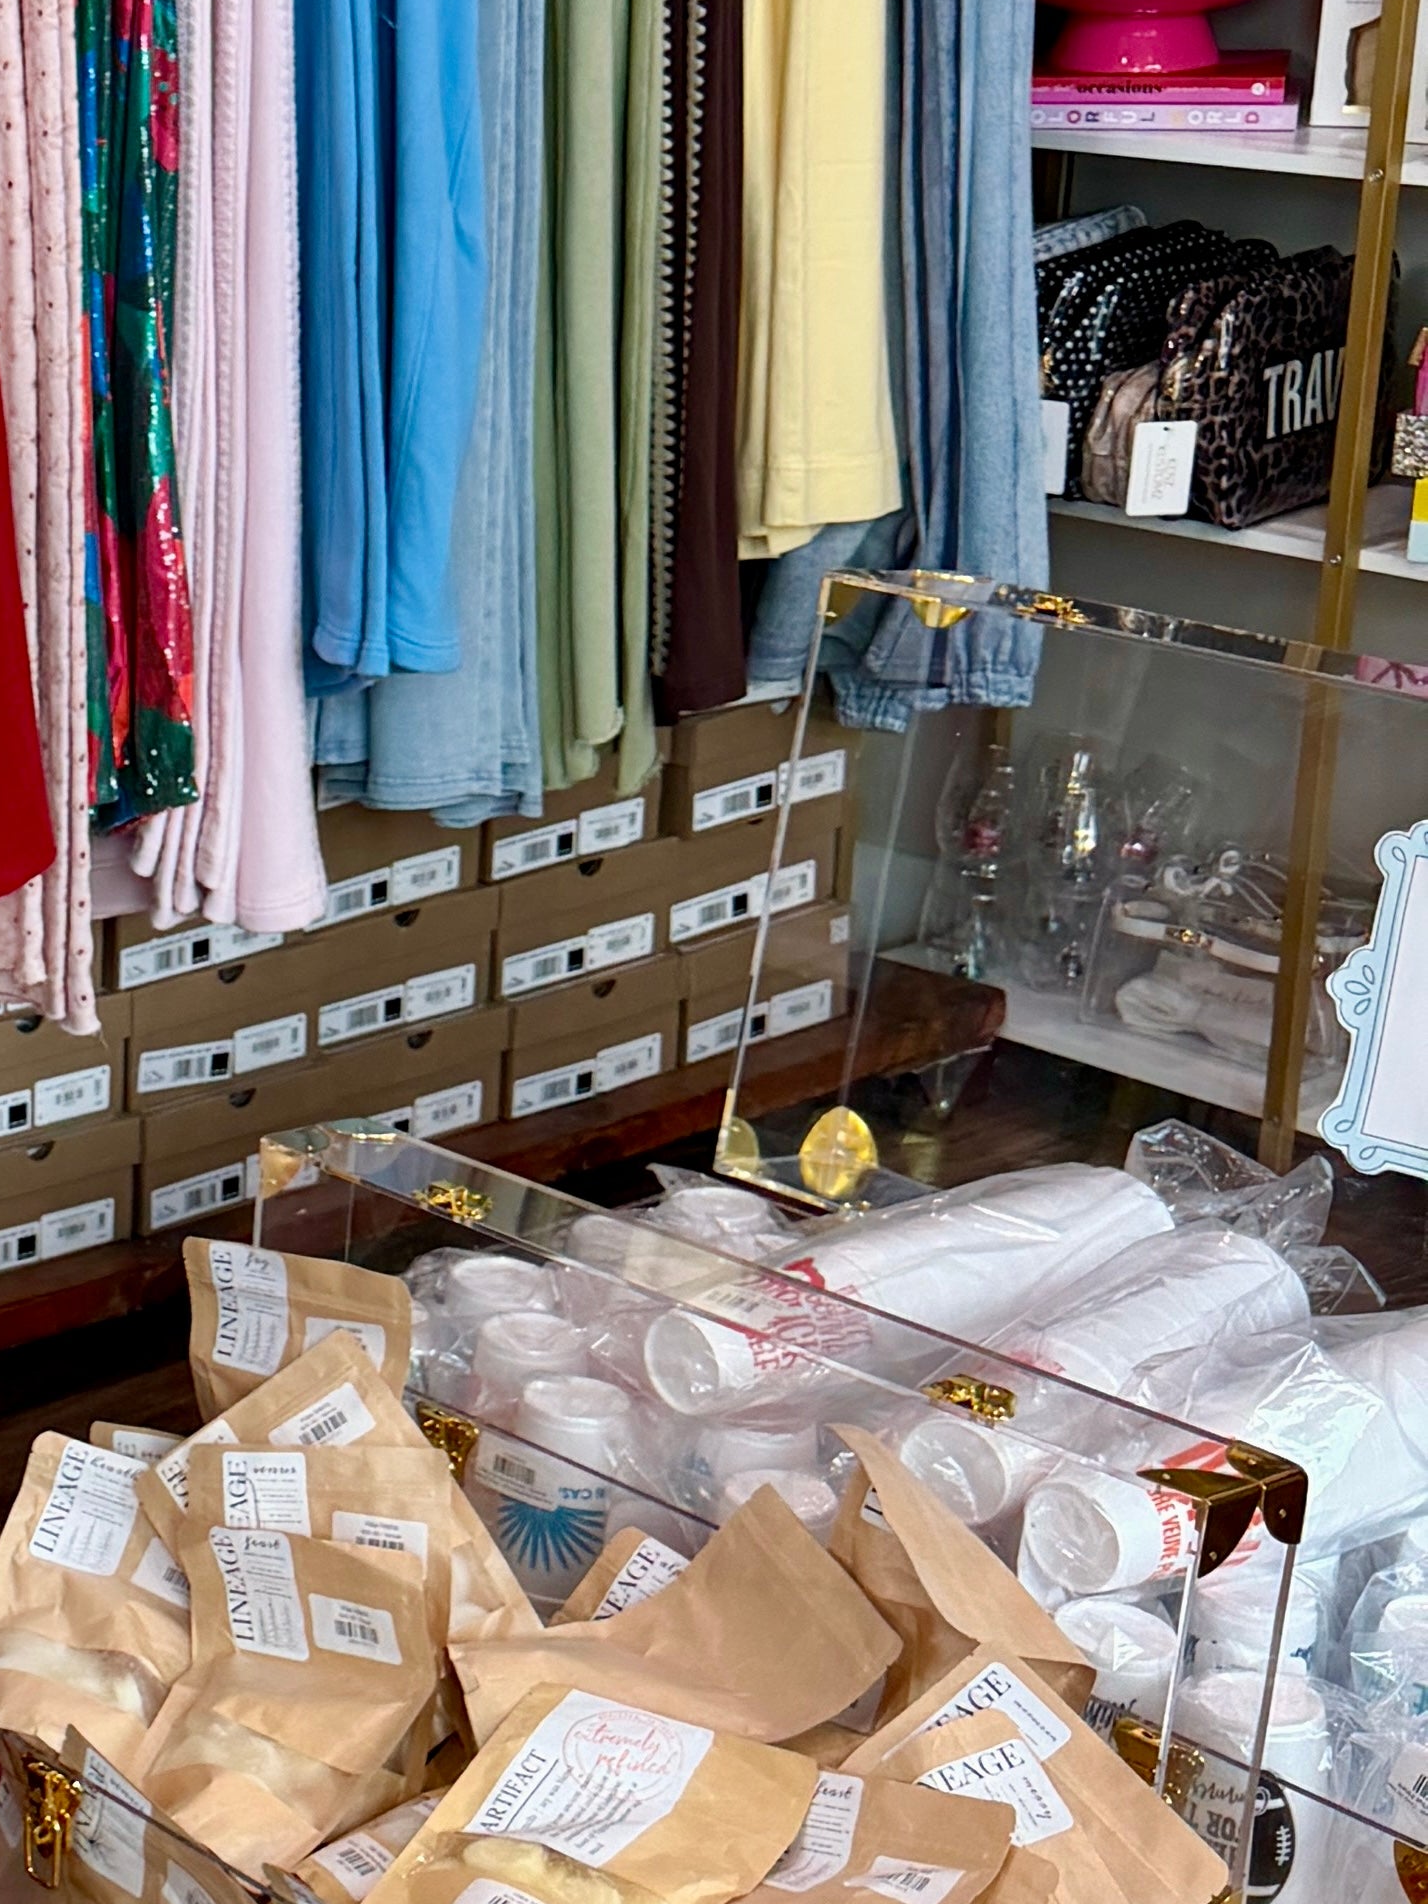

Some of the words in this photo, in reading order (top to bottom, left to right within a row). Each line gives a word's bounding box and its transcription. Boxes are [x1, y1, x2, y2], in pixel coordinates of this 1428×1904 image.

[211, 1249, 239, 1357] LINEAGE
[33, 1446, 89, 1553] LINEAGE
[211, 1533, 255, 1641] LINEAGE
[480, 1748, 547, 1833] ARTIFACT
